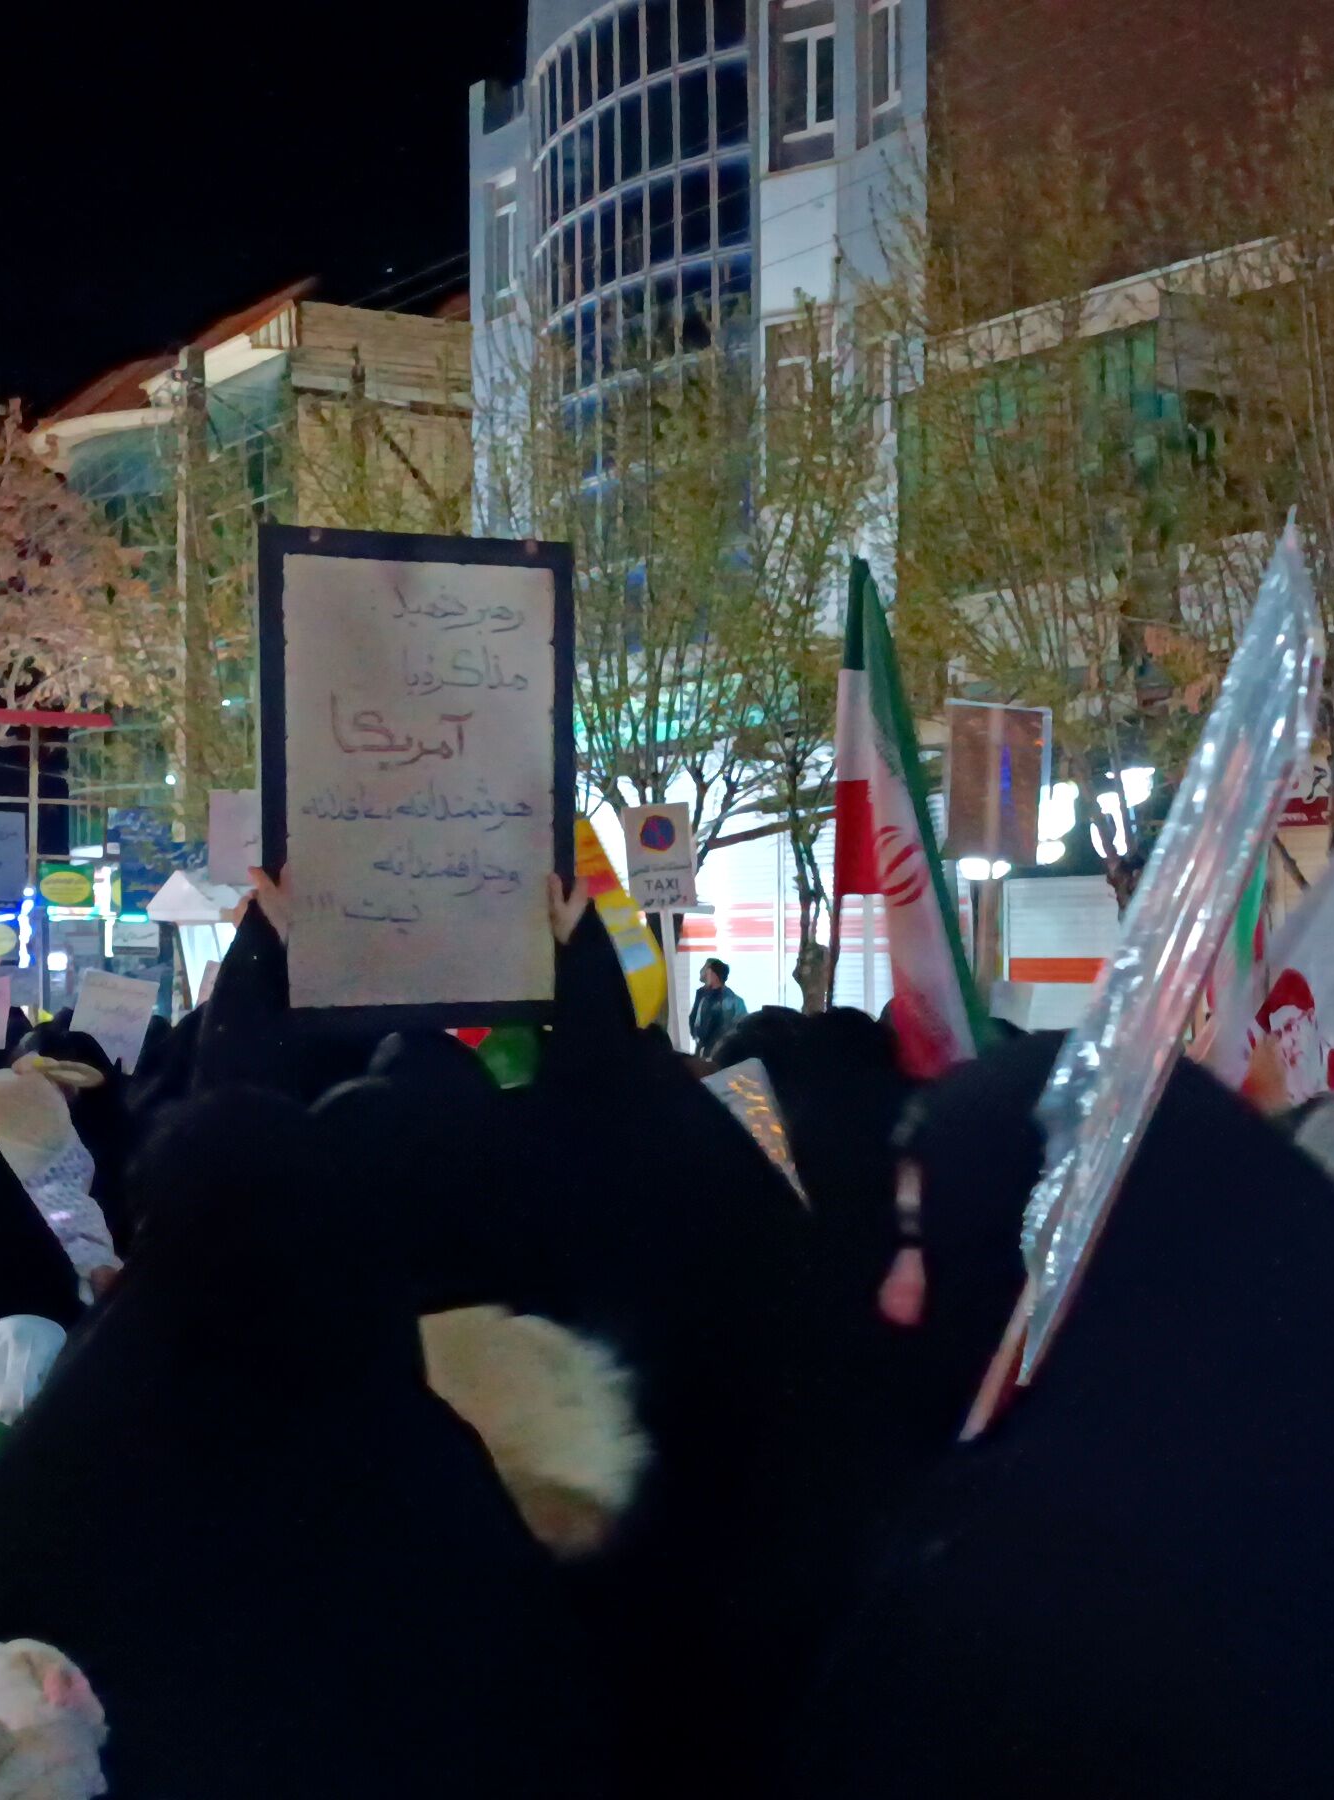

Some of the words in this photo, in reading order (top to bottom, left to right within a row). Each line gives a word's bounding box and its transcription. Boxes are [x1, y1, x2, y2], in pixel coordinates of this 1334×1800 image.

[441, 605, 525, 635] رهبر
[330, 692, 473, 771] آمریکا
[643, 877, 680, 891] TAXI
[342, 889, 423, 935] نیست
